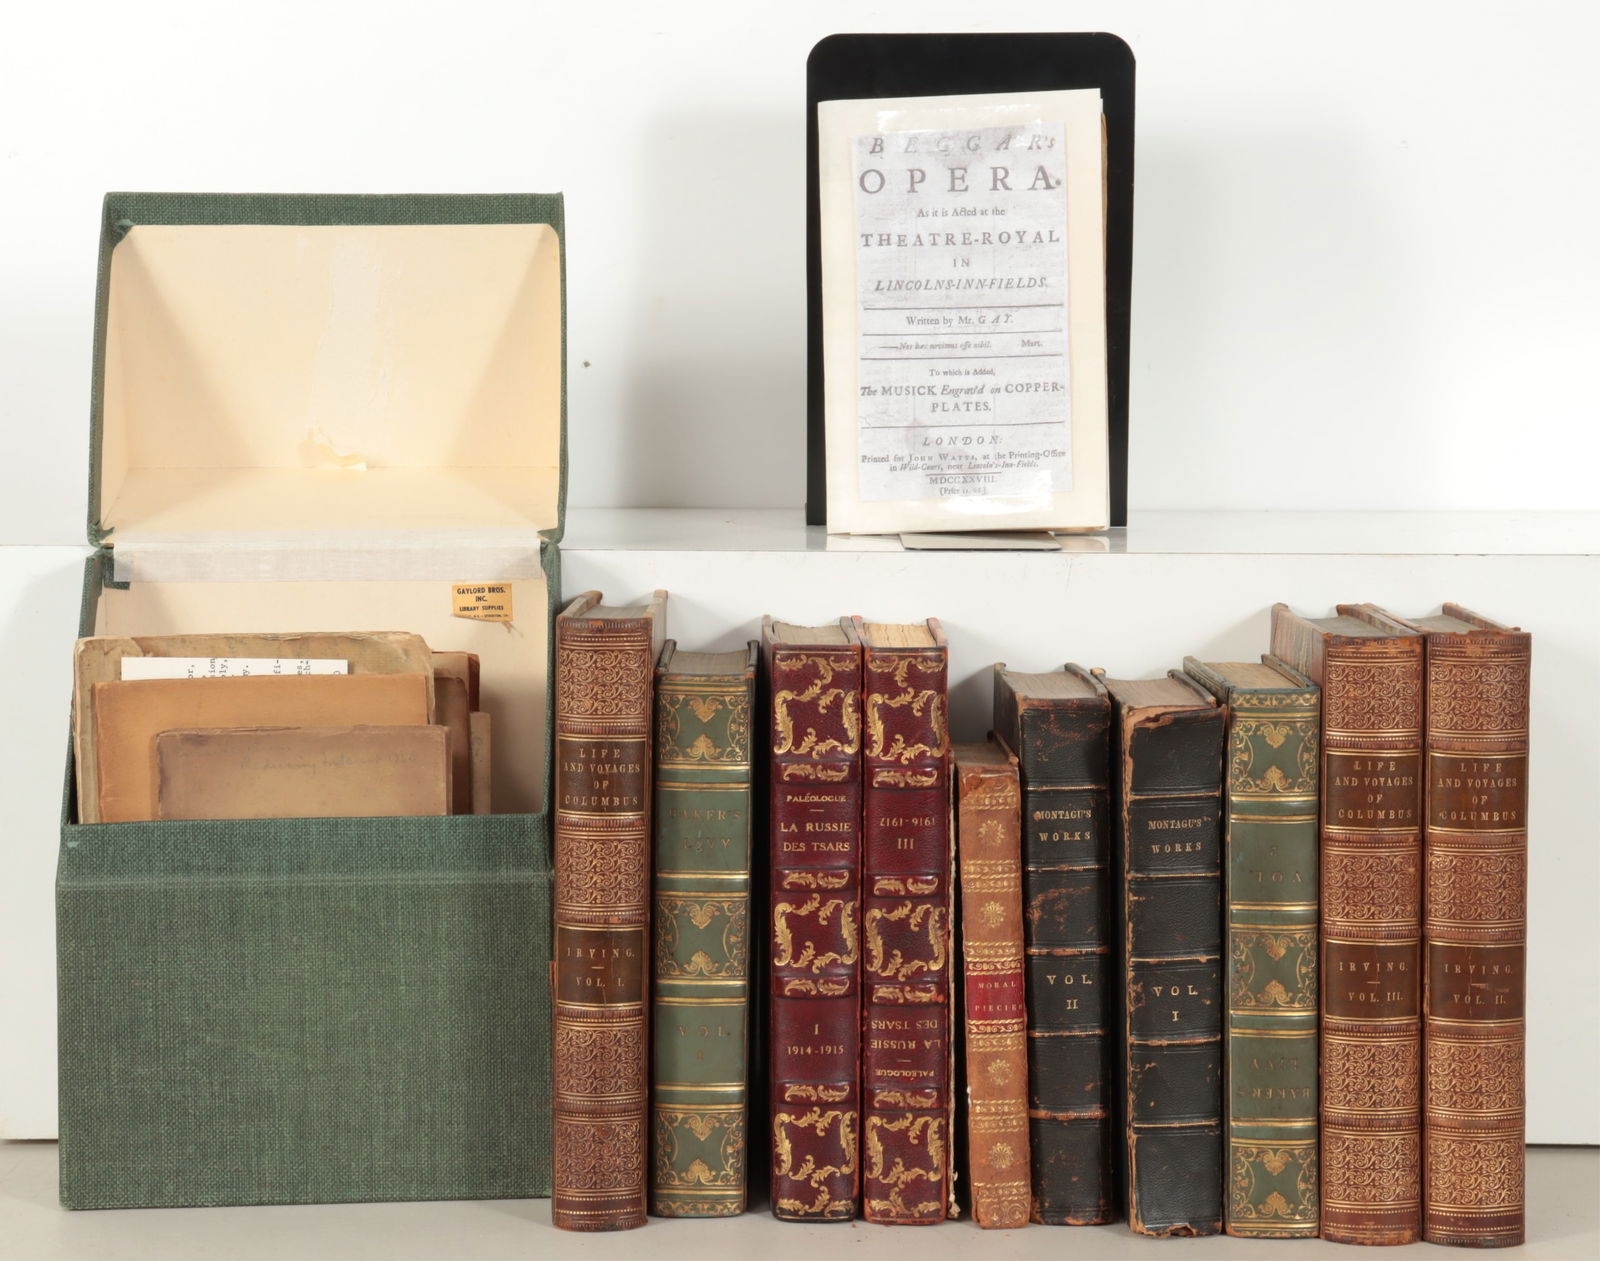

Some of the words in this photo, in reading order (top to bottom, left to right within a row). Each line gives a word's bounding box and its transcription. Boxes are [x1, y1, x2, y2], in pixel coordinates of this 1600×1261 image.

[858, 165, 1062, 194] OPERA.
[917, 208, 930, 218] As
[932, 208, 938, 217] it
[941, 208, 949, 217] is
[952, 207, 977, 217] Acted
[980, 208, 988, 217] at
[992, 207, 1006, 217] the
[861, 230, 1061, 248] THEATRE-ROYAL
[953, 258, 970, 268] IN
[906, 315, 940, 326] Written
[942, 315, 953, 328] by
[958, 315, 975, 326] Mr.
[929, 369, 940, 377] To
[942, 368, 962, 377] which
[860, 386, 877, 397] The
[881, 385, 937, 397] MUSICK
[1005, 382, 1064, 394] COPPER-
[931, 401, 992, 413] PLATES.
[457, 587, 485, 595] GAYLORD
[580, 748, 620, 759] LIFE
[564, 762, 584, 773] AND
[590, 763, 640, 774] VOYAGES
[1354, 761, 1396, 772] LIFE
[1461, 762, 1502, 773] LIFE
[594, 780, 609, 790] OF
[1334, 776, 1358, 787] AND
[1364, 776, 1414, 787] VOYAGES
[1437, 778, 1461, 788] AND
[1468, 778, 1517, 788] VOYAGES
[565, 794, 638, 806] COLUMBUS
[786, 793, 847, 803] PALÉOLOGUE
[1367, 794, 1384, 804] OF
[1472, 795, 1488, 805] OF
[1035, 810, 1092, 820] MONTAGU'S
[1338, 809, 1412, 819] COLUMBUS
[1441, 810, 1516, 821] COLUMBUS
[780, 822, 798, 833] LA
[806, 822, 852, 833] RUSSIE
[1148, 819, 1202, 830] MONTAGU'S
[1039, 831, 1091, 842] WORKS
[783, 842, 805, 852] DES
[812, 842, 850, 852] TSARS
[897, 838, 914, 849] III
[1152, 841, 1202, 854] WORKS
[1339, 961, 1408, 973] IRVING.
[576, 976, 606, 988] VOL.
[1348, 992, 1379, 1003] VOL.
[1453, 994, 1485, 1005] VOL.
[1066, 999, 1079, 1010] II
[1171, 1011, 1179, 1021] I
[814, 1024, 819, 1035] I
[871, 1020, 910, 1030] TSARS
[915, 1020, 938, 1029] DES
[871, 1039, 916, 1049] RUSSIE
[924, 1039, 941, 1049] LA
[875, 1069, 935, 1080] PALÉOLOGUE
